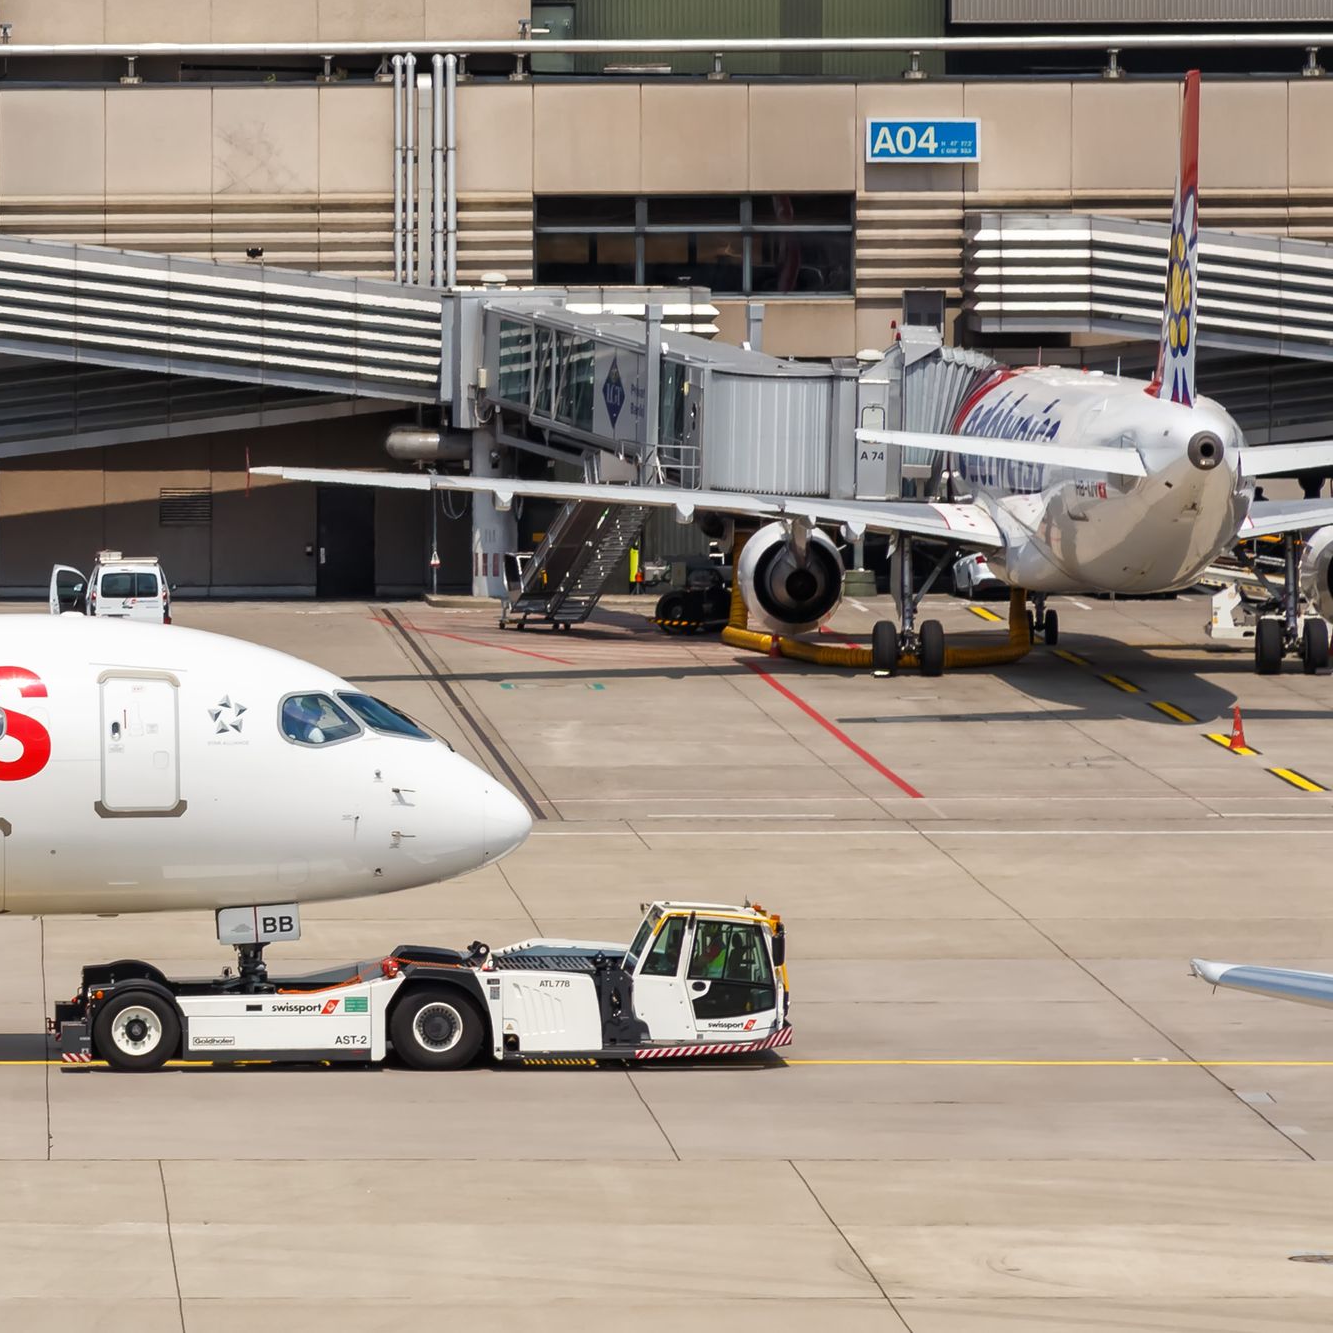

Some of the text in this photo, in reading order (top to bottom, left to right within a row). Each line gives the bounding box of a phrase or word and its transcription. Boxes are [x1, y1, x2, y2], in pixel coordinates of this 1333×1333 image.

[873, 125, 939, 155] A04
[860, 451, 884, 461] A 74
[262, 915, 295, 934] BB
[271, 1002, 322, 1014] swissport
[708, 1021, 744, 1030] swissport
[335, 1035, 368, 1045] AST-2
